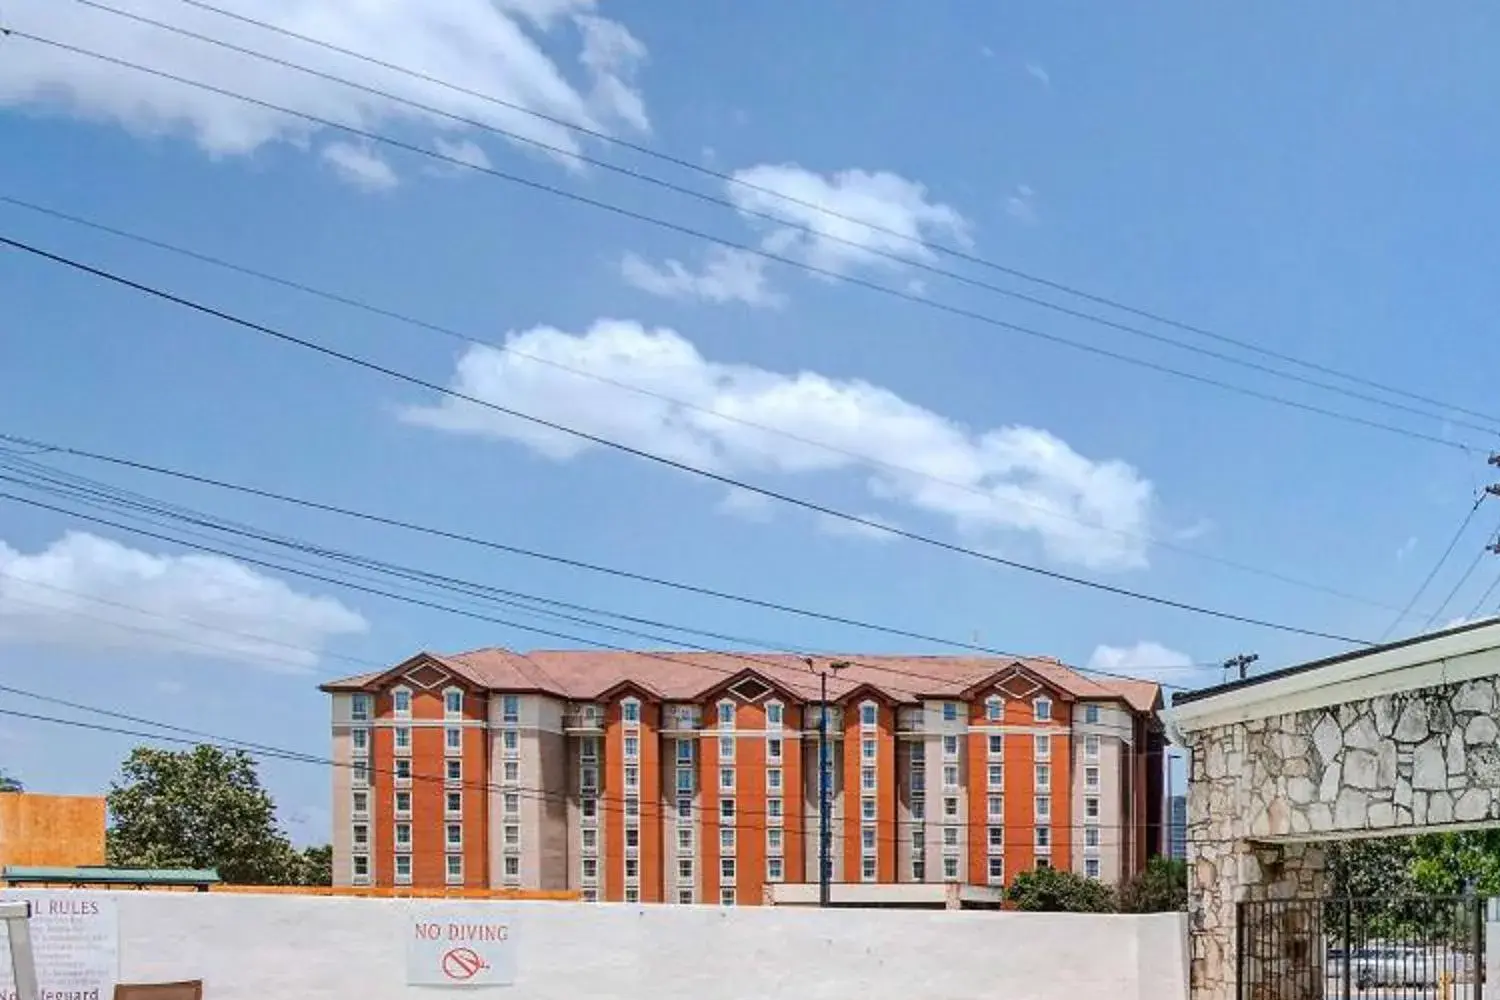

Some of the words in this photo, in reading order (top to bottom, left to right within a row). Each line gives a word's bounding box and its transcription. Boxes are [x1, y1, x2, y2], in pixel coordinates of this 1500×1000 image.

[49, 900, 99, 915] RULES
[415, 923, 441, 940] NO
[448, 924, 508, 941] DIVING
